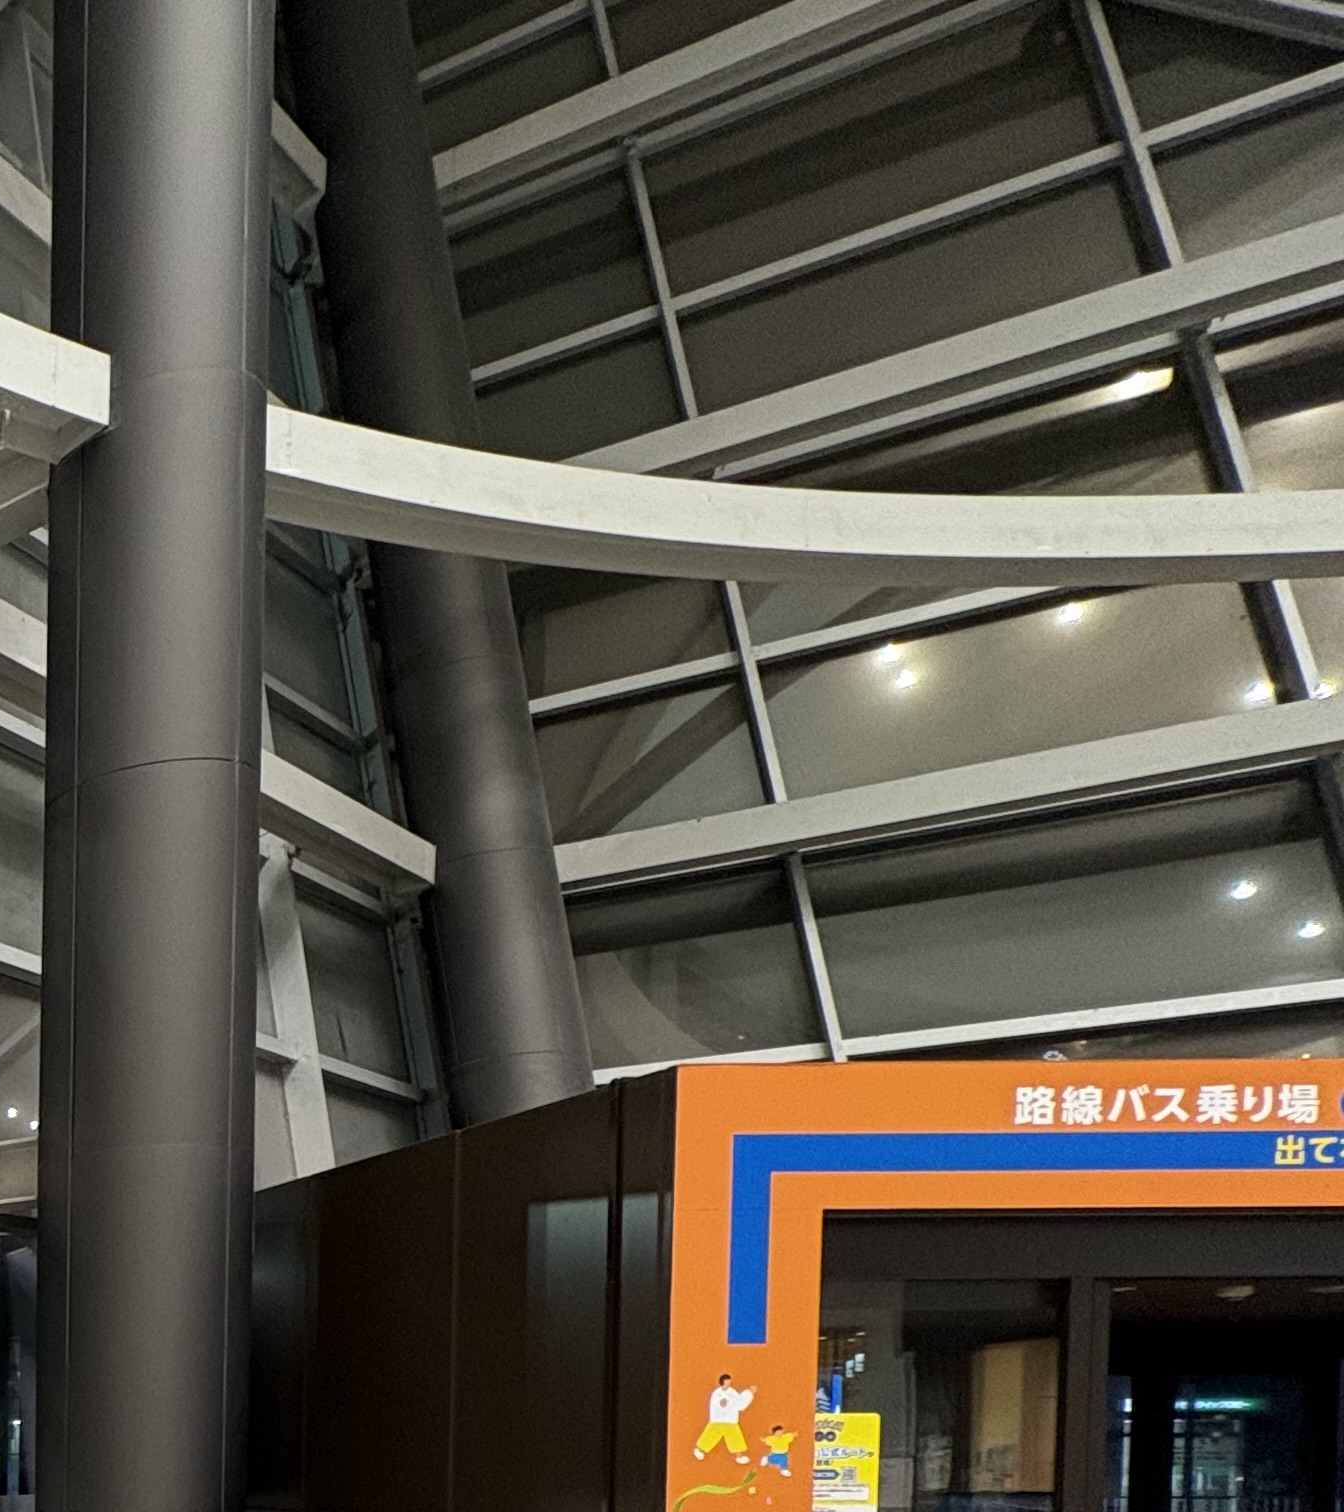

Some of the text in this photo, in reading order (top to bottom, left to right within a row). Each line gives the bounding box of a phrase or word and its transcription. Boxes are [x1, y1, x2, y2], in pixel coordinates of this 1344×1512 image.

[1014, 1084, 1320, 1125] 路線バス乗り場
[1274, 1135, 1344, 1165] 出て
